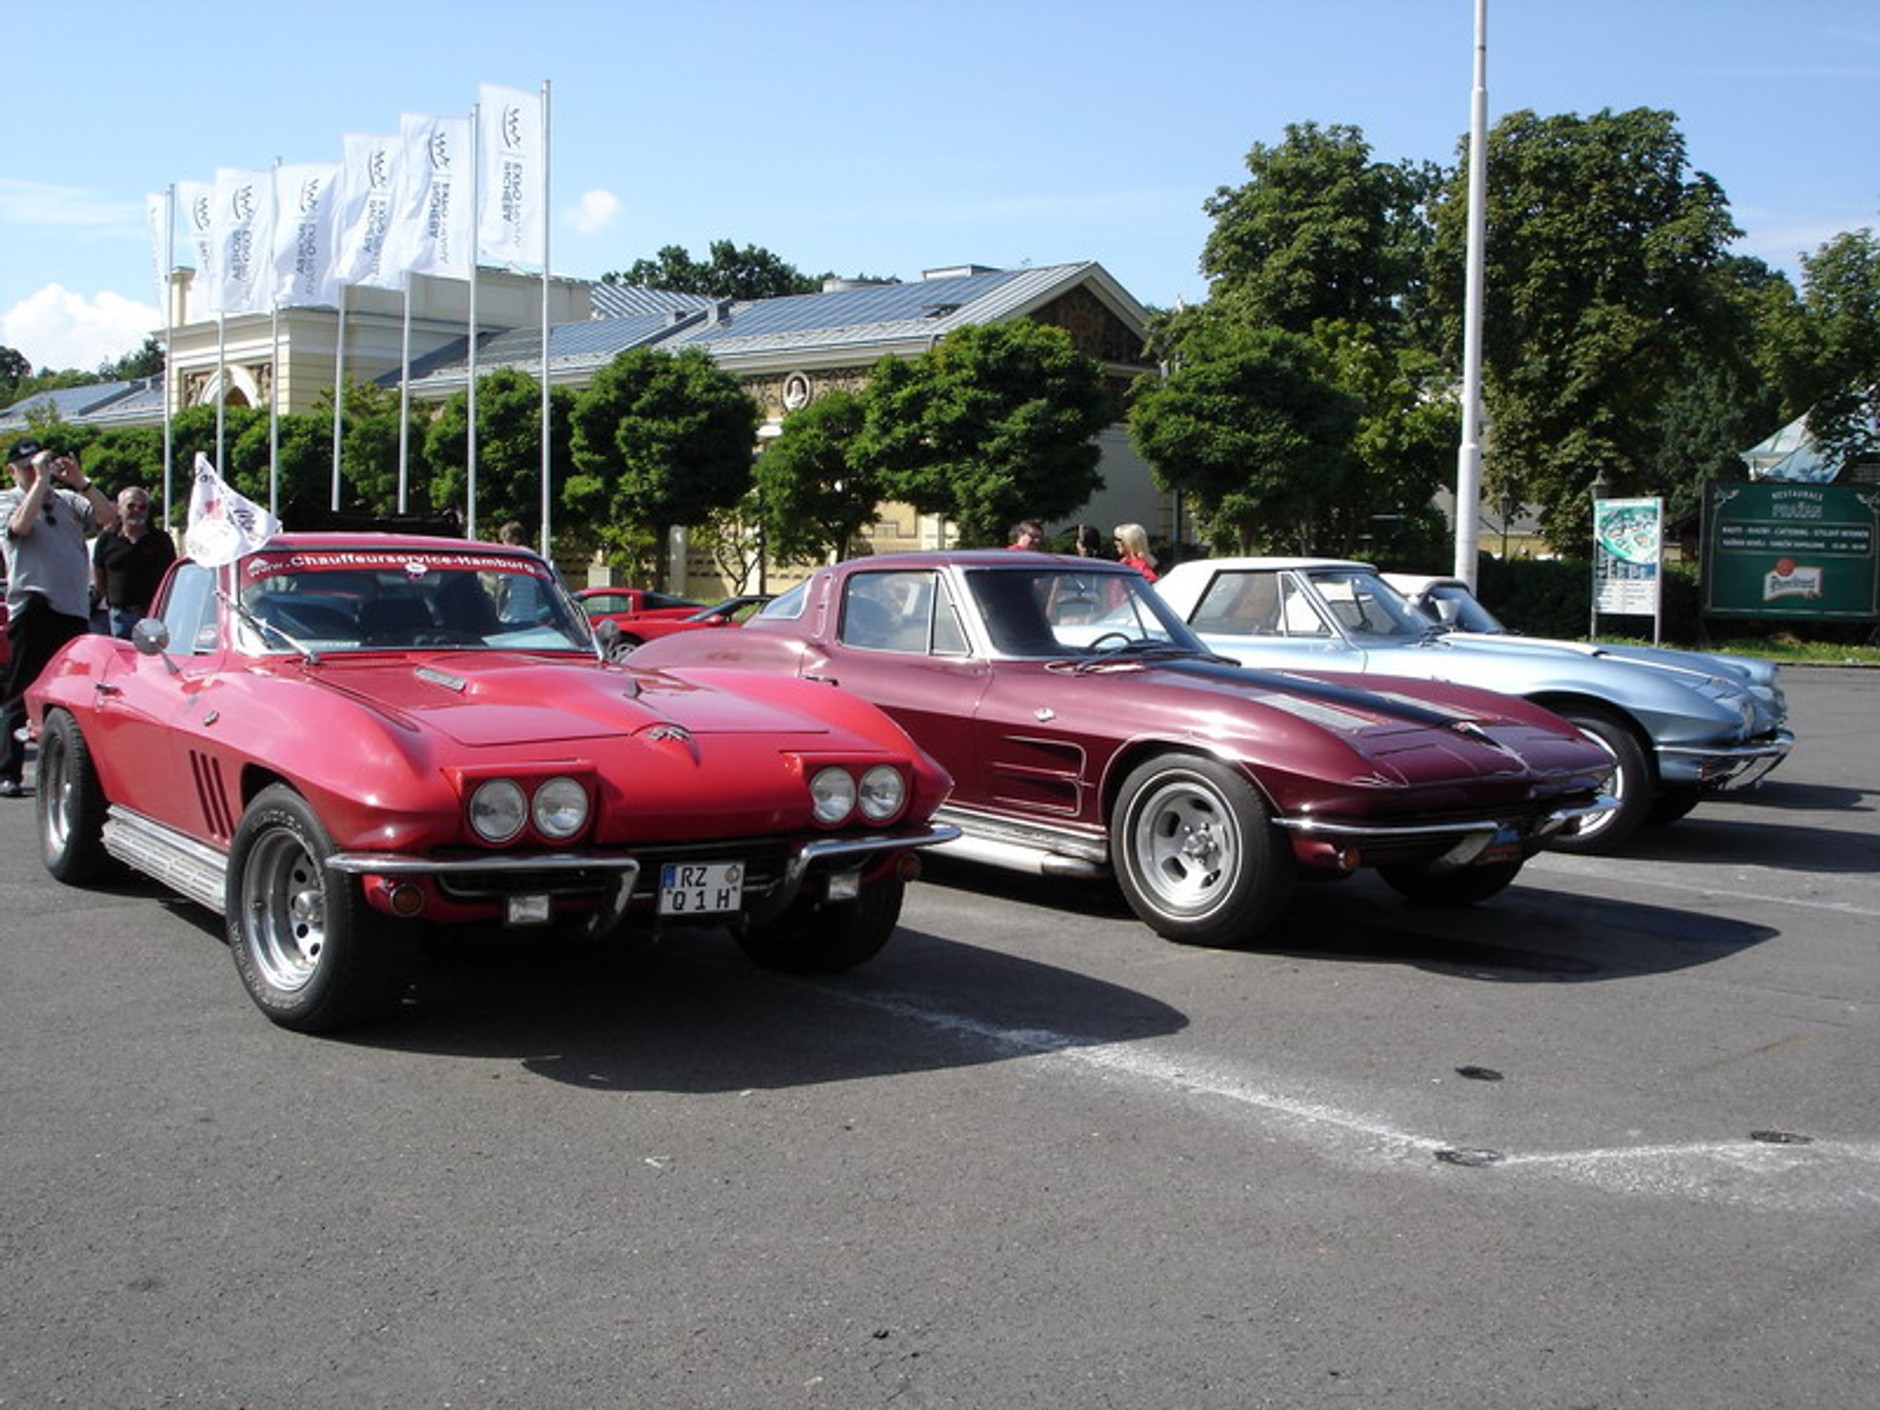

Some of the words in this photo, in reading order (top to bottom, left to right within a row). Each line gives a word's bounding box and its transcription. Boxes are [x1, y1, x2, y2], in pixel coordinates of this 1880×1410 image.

[681, 867, 707, 888] RZ
[672, 890, 686, 911] Q
[695, 890, 706, 910] 1
[716, 888, 730, 908] H
